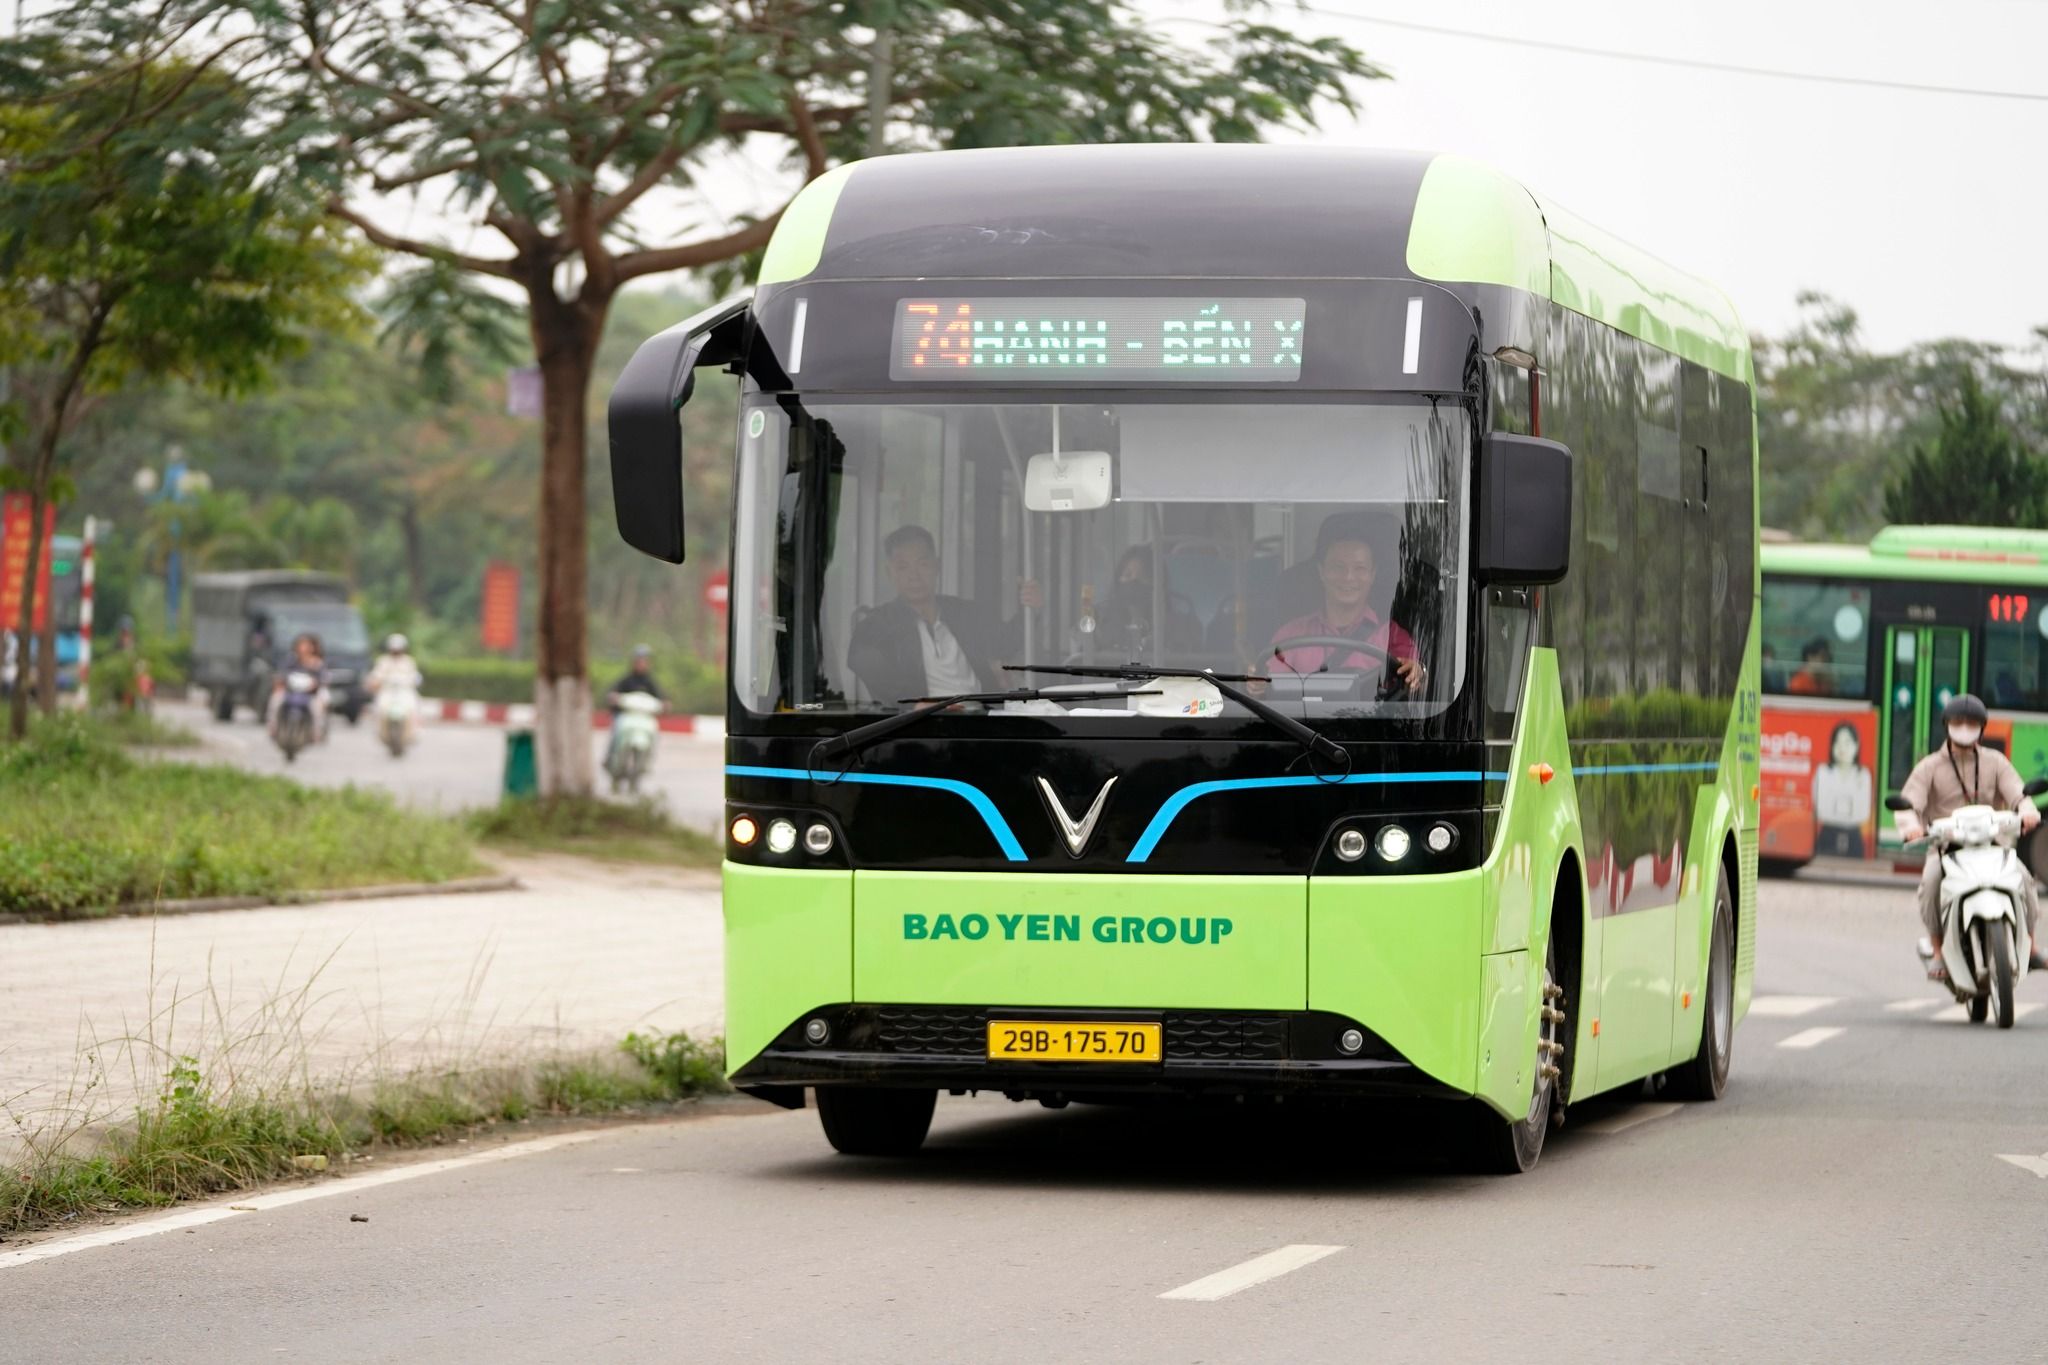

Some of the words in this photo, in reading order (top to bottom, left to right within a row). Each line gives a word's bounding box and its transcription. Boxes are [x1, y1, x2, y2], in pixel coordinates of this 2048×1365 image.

[908, 304, 970, 364] 74
[973, 320, 1106, 364] HANH
[1273, 320, 1302, 364] X
[1989, 593, 2029, 623] 117
[903, 913, 990, 940] BAO
[996, 914, 1080, 941] YEN
[1092, 916, 1233, 944] GROUP
[1003, 1030, 1145, 1054] 29B-175.70
